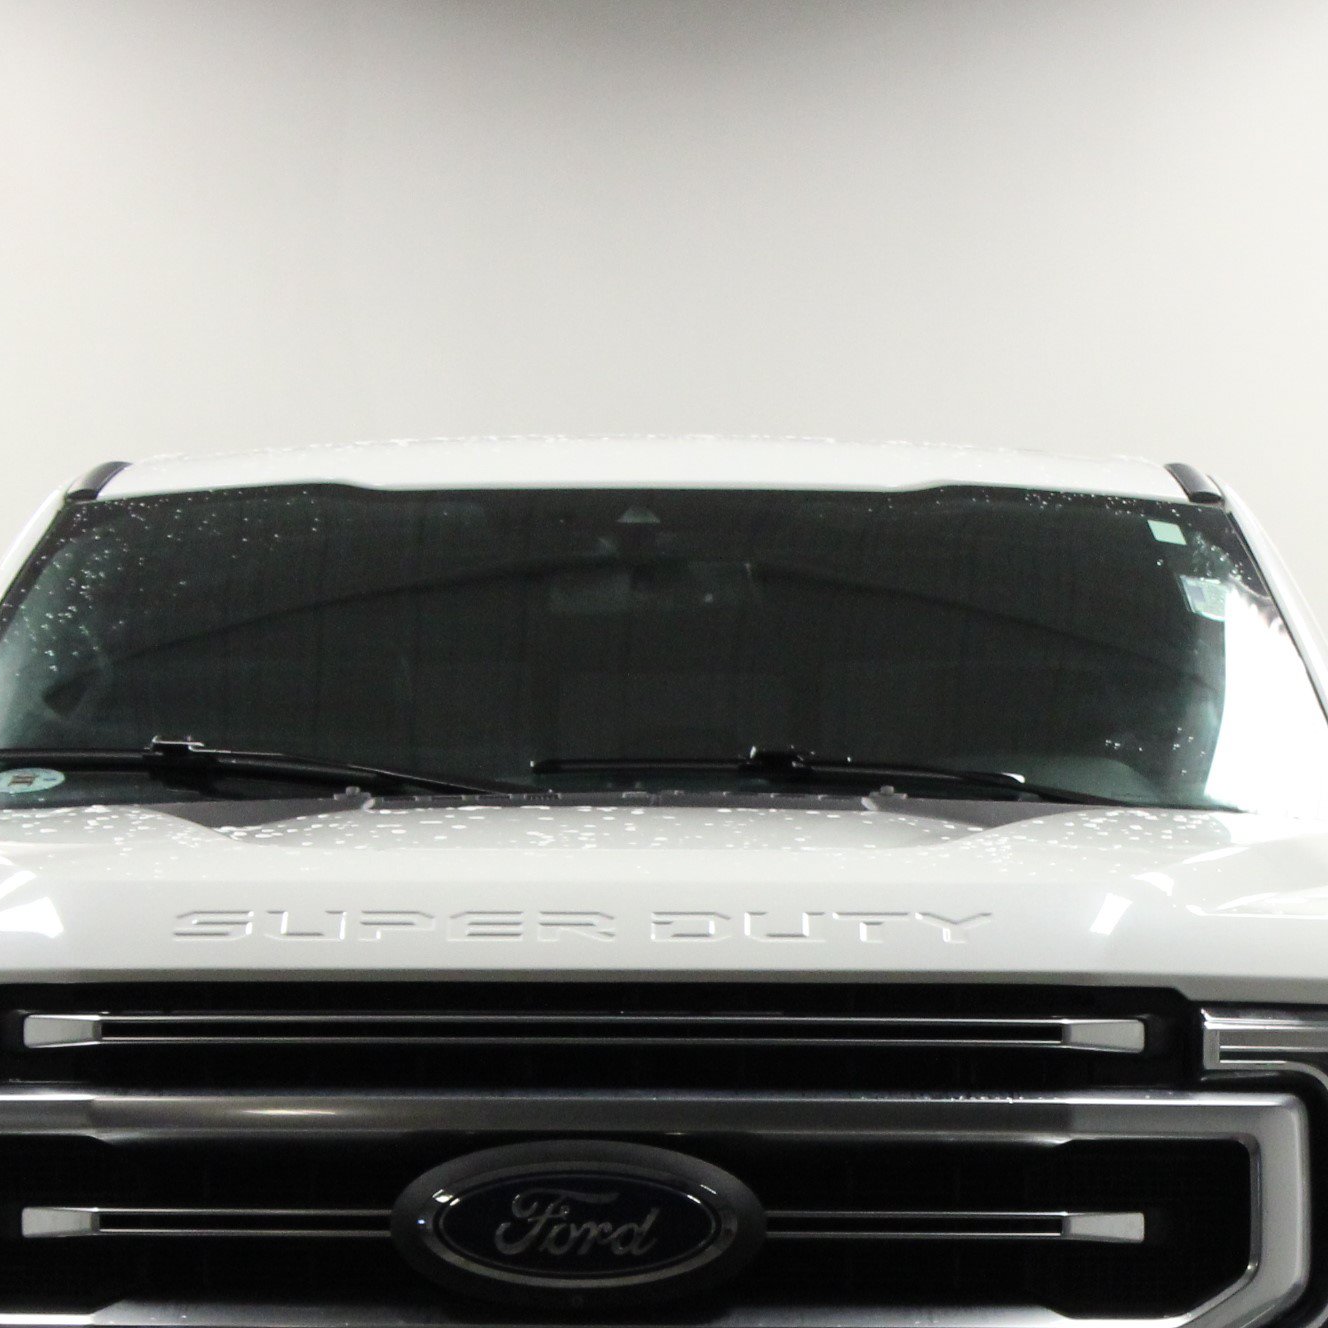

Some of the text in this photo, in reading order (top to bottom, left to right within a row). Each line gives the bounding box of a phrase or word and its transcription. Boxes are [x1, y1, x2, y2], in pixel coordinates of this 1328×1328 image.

[172, 909, 993, 944] SUPER DUTY
[493, 1187, 661, 1257] Ford
